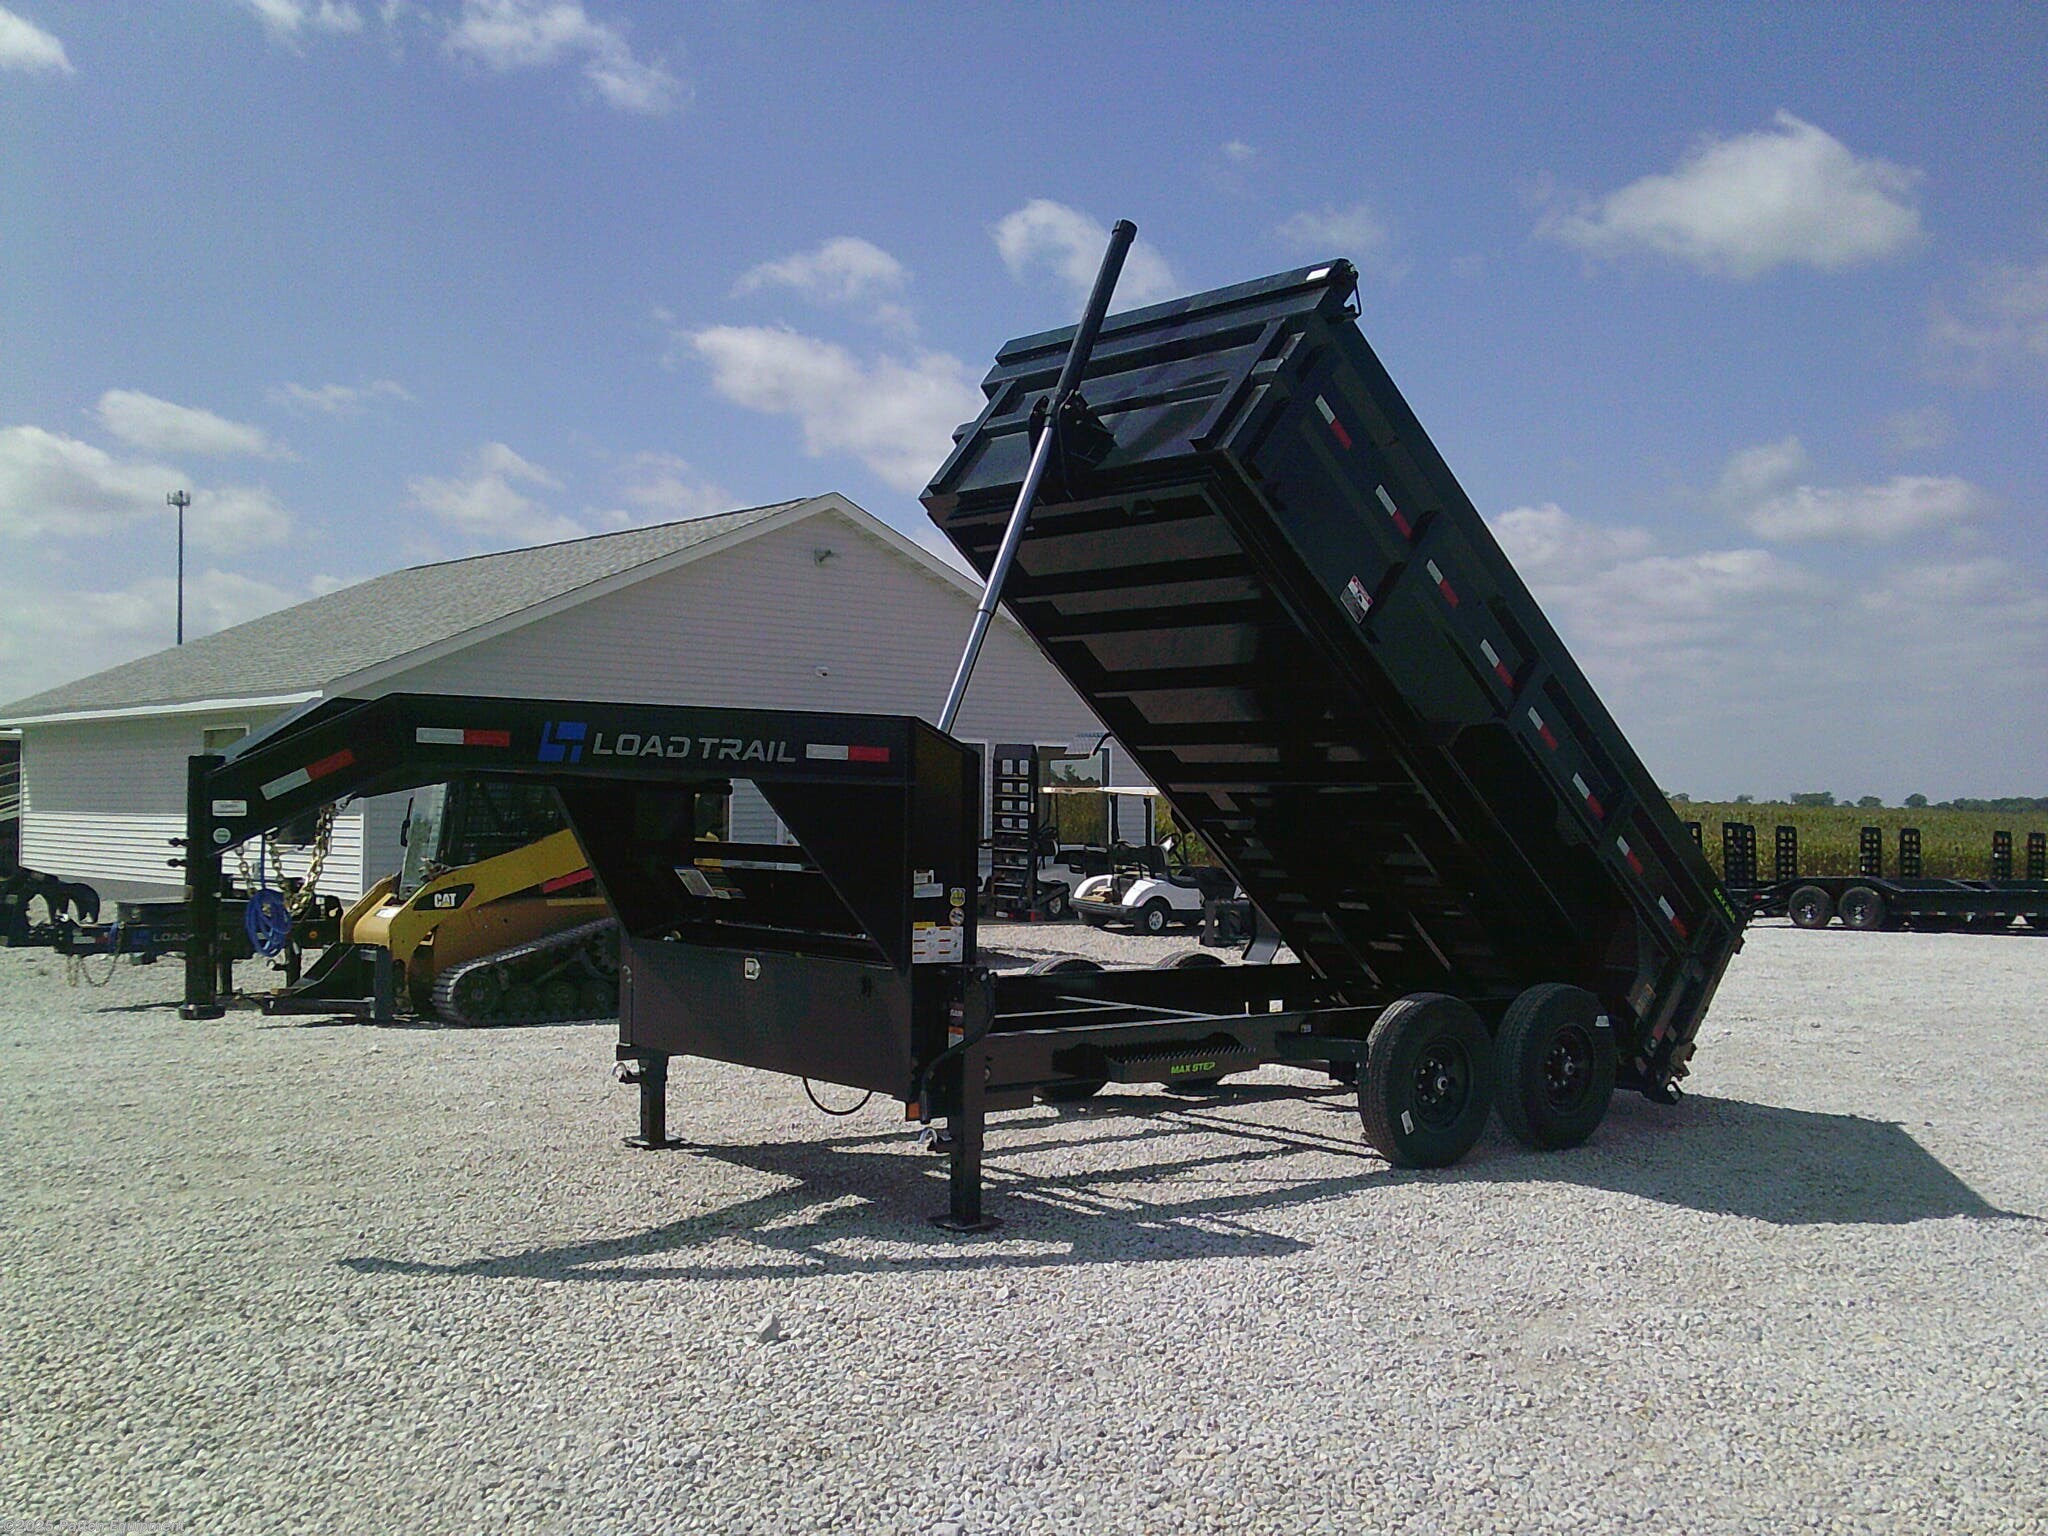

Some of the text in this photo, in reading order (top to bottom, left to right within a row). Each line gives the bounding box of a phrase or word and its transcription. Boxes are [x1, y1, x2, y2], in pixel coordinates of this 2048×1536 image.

[592, 732, 797, 763] LOAD TRAIL
[434, 893, 457, 908] CAT
[1170, 1062, 1216, 1074] MAX STEP
